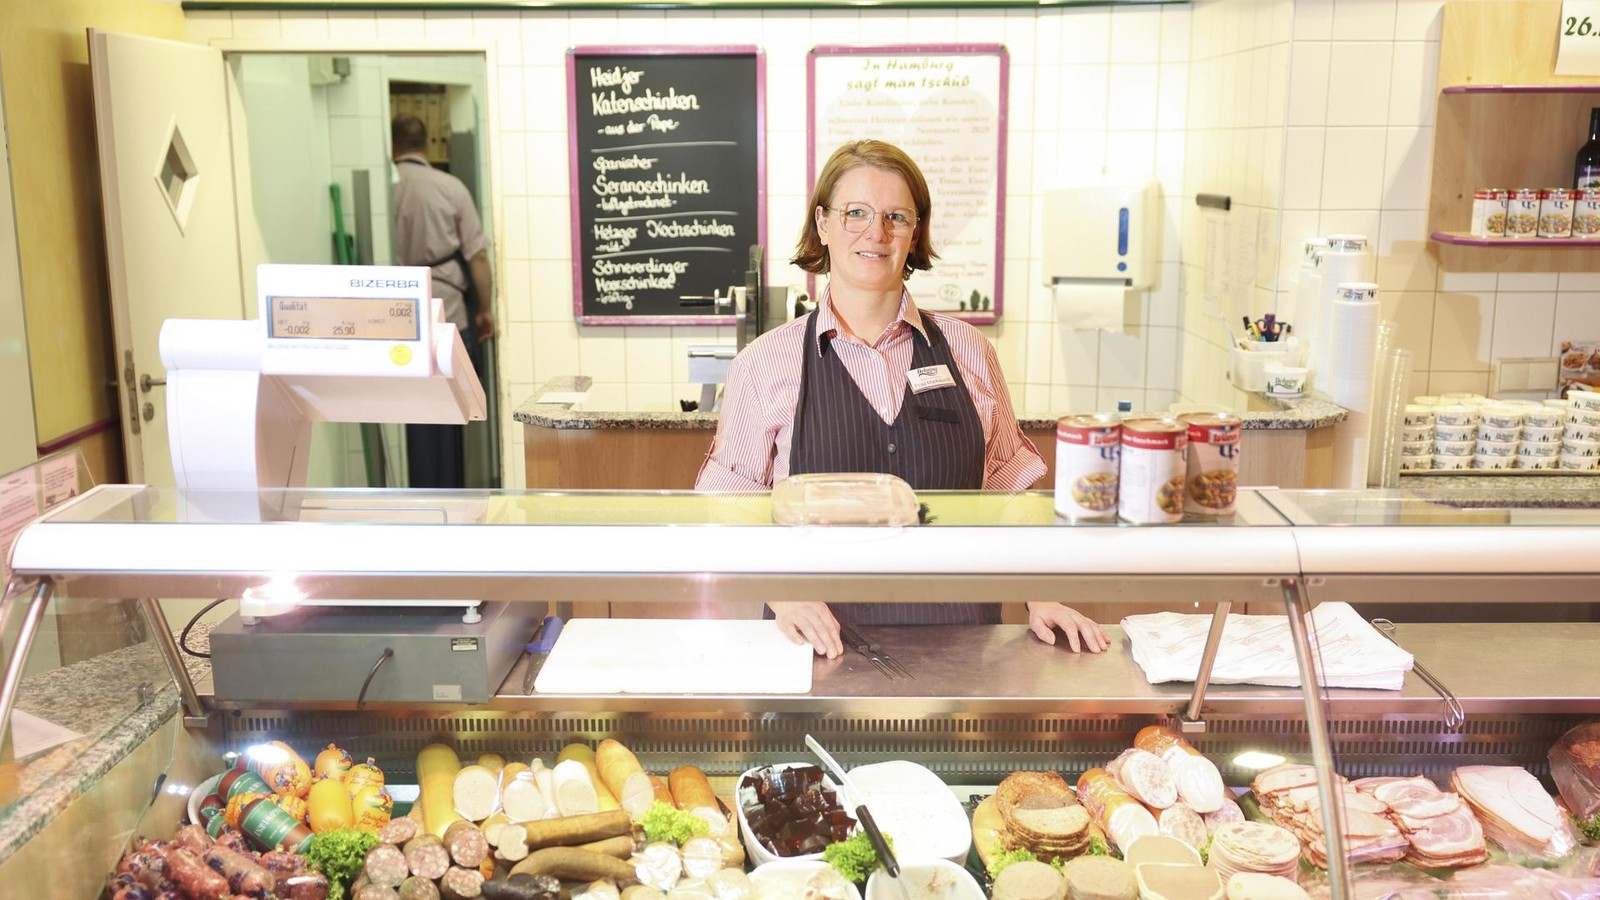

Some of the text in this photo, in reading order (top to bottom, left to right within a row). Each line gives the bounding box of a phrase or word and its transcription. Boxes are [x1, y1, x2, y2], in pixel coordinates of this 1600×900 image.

[1564, 16, 1600, 37] 26.
[863, 57, 954, 72] In Hamburg
[846, 74, 970, 92] sagt man tschüß
[592, 88, 699, 115] Katenschinken
[349, 278, 419, 289] BIZERBA
